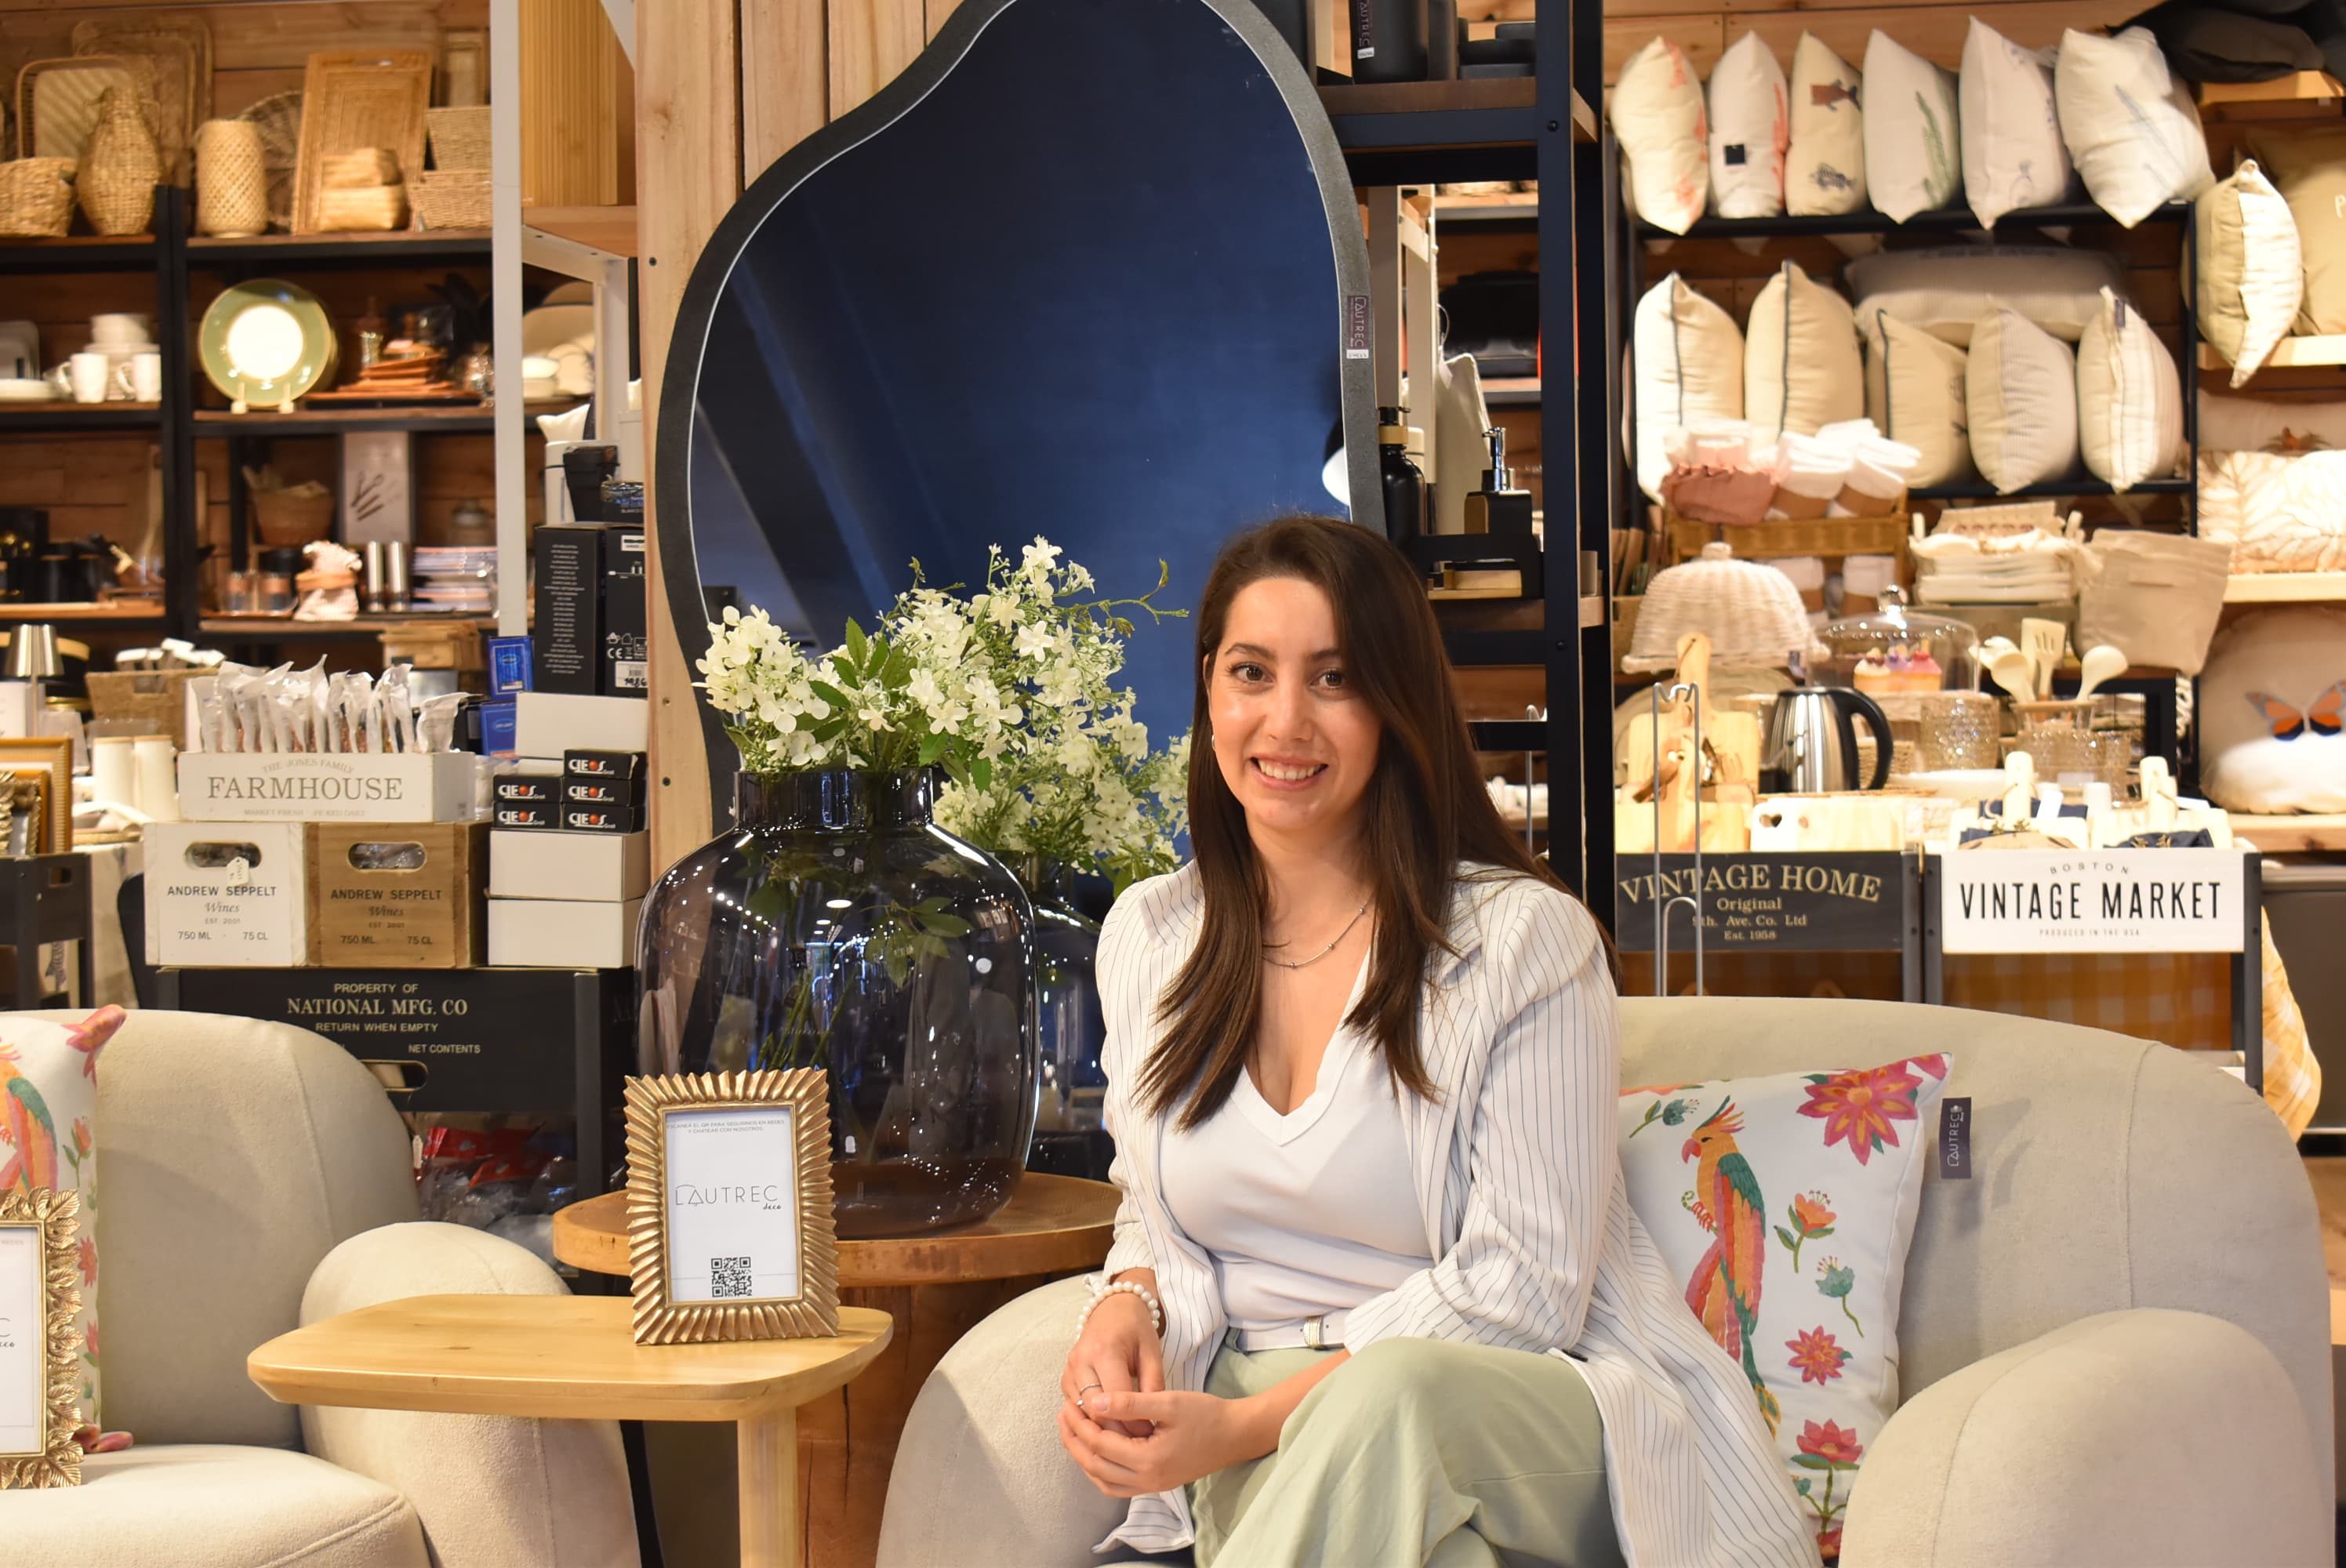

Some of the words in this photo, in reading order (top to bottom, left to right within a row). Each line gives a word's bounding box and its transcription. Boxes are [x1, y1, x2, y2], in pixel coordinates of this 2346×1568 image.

[1360, 0, 1370, 45] AUTREC
[262, 762, 283, 773] THE
[320, 759, 354, 774] FAMILY
[208, 776, 402, 800] FARMHOUSE
[2050, 862, 2129, 874] BOSTON
[1618, 864, 1770, 904] VINTAGE
[1780, 865, 1882, 902] HOME
[167, 886, 220, 896] ANDREW
[226, 886, 276, 896] SEPPELT
[331, 889, 383, 900] ANDREW
[390, 890, 442, 900] SEPPELT
[204, 901, 240, 913] Wines
[1716, 897, 1782, 914] Original
[1960, 882, 2081, 920] VINTAGE
[2102, 882, 2221, 919] MARKET
[368, 905, 404, 916] Wines
[1726, 915, 1752, 926] Ave.
[1756, 915, 1778, 927] Co.
[1785, 914, 1807, 926] Ltd
[178, 931, 196, 940] 750
[198, 931, 212, 940] ML
[243, 931, 255, 940] 75
[256, 931, 268, 940] CL
[340, 935, 360, 945] 750
[361, 935, 376, 945] ML
[407, 936, 419, 945] 75
[421, 936, 433, 945] CL
[334, 983, 397, 993] PROPERTY
[402, 984, 419, 993] OF
[287, 998, 385, 1014] NATIONAL
[392, 999, 437, 1015] MFG.
[442, 999, 468, 1015] CO
[316, 1022, 360, 1033] RETURN
[364, 1023, 397, 1032] WHEN
[401, 1023, 438, 1033] EMPTY
[409, 1044, 427, 1054] NET
[429, 1044, 481, 1054] CONTENTS
[676, 1185, 778, 1207] LAUTREC
